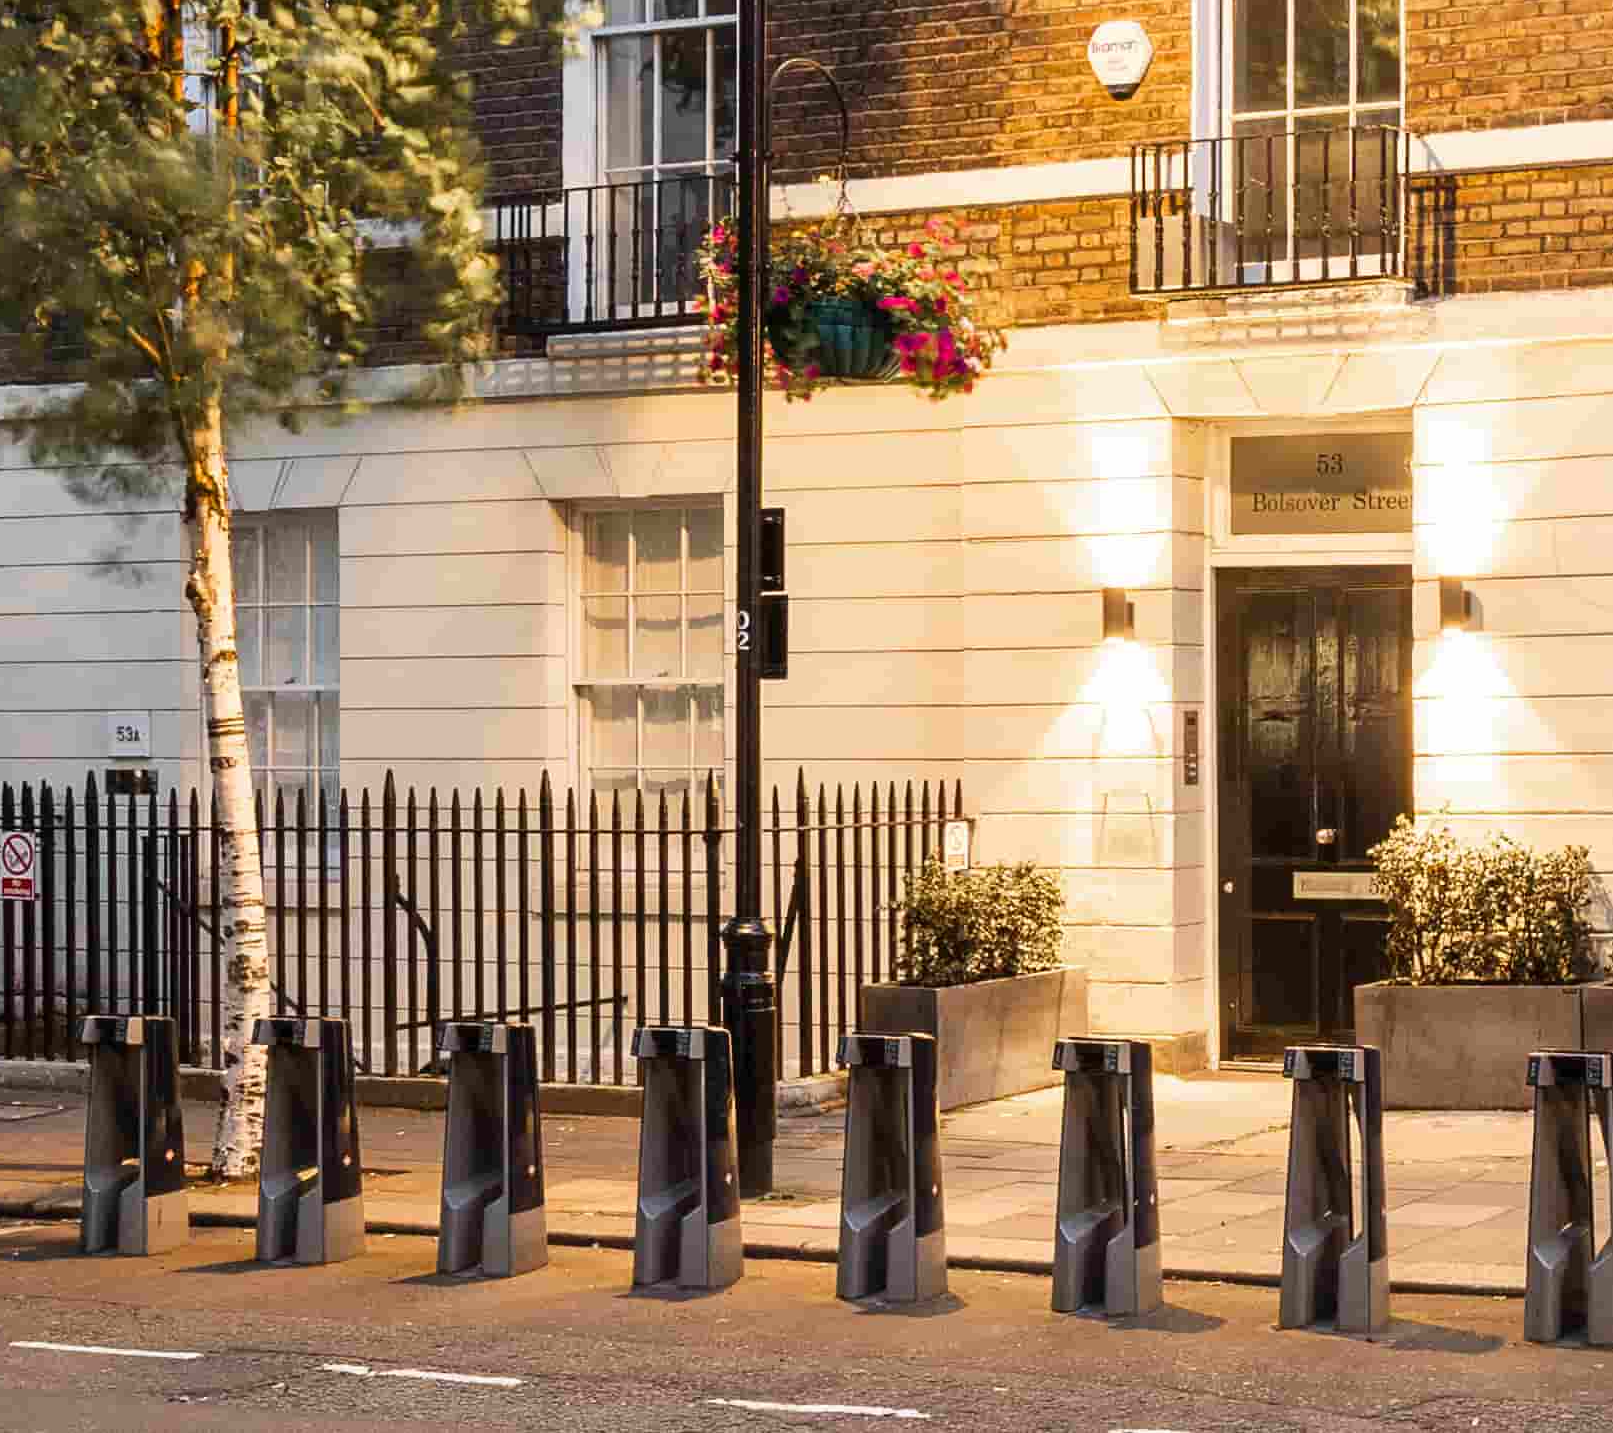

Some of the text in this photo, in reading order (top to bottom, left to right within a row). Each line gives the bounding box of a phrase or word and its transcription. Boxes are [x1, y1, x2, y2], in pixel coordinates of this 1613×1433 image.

[1315, 452, 1343, 476] 53
[1252, 489, 1413, 514] Bolsover Stree
[115, 725, 141, 742] 53A
